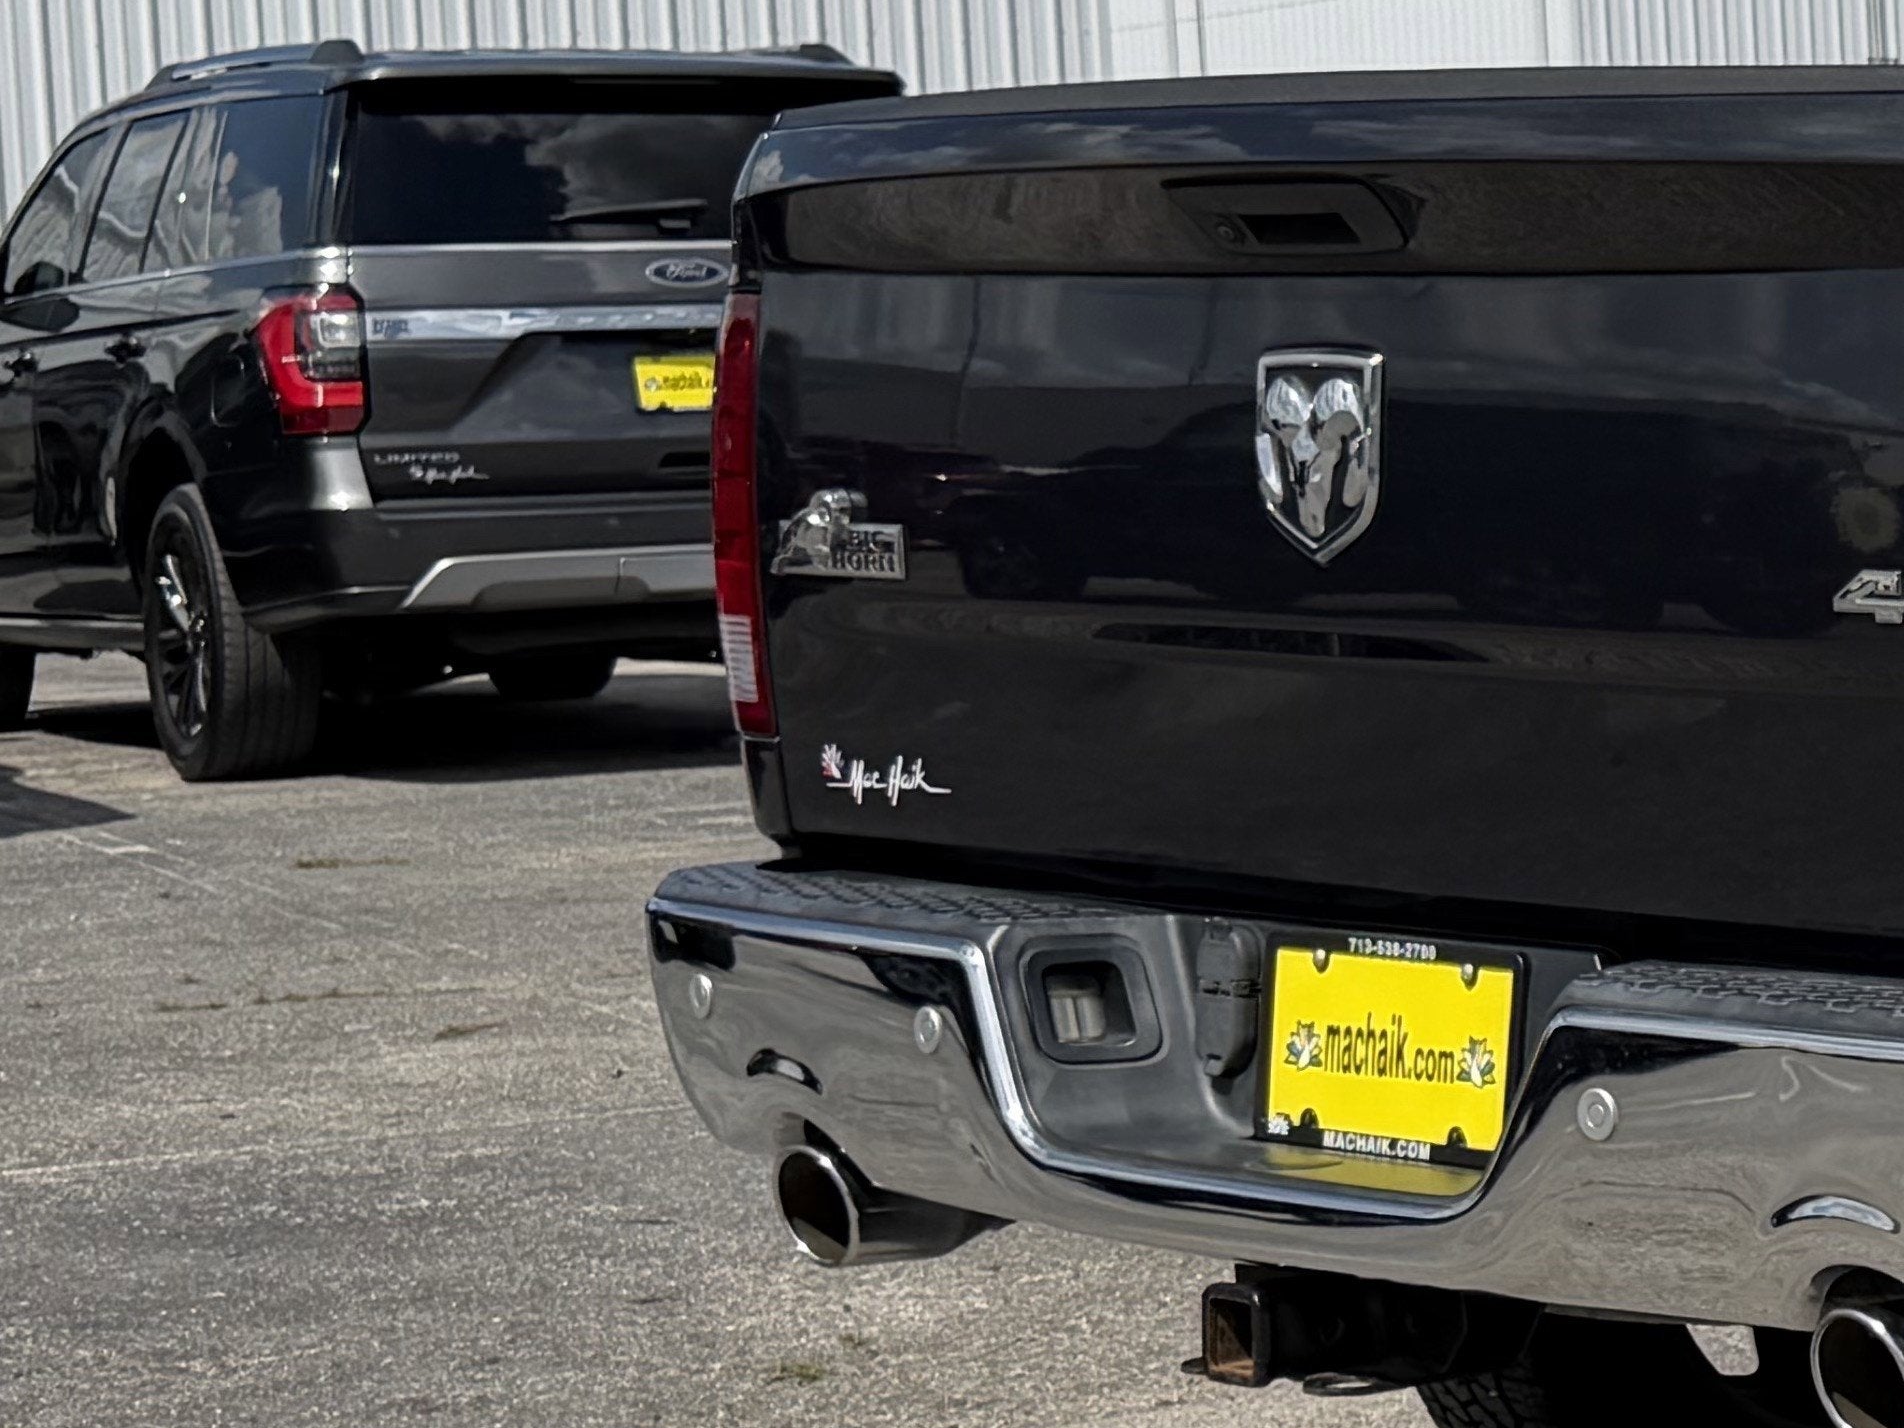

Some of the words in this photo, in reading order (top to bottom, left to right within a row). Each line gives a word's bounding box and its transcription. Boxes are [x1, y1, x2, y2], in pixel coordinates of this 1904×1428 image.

[830, 551, 896, 573] HORN
[1323, 1011, 1456, 1085] machaik.com
[1322, 1129, 1431, 1162] MACHAIK.COM
